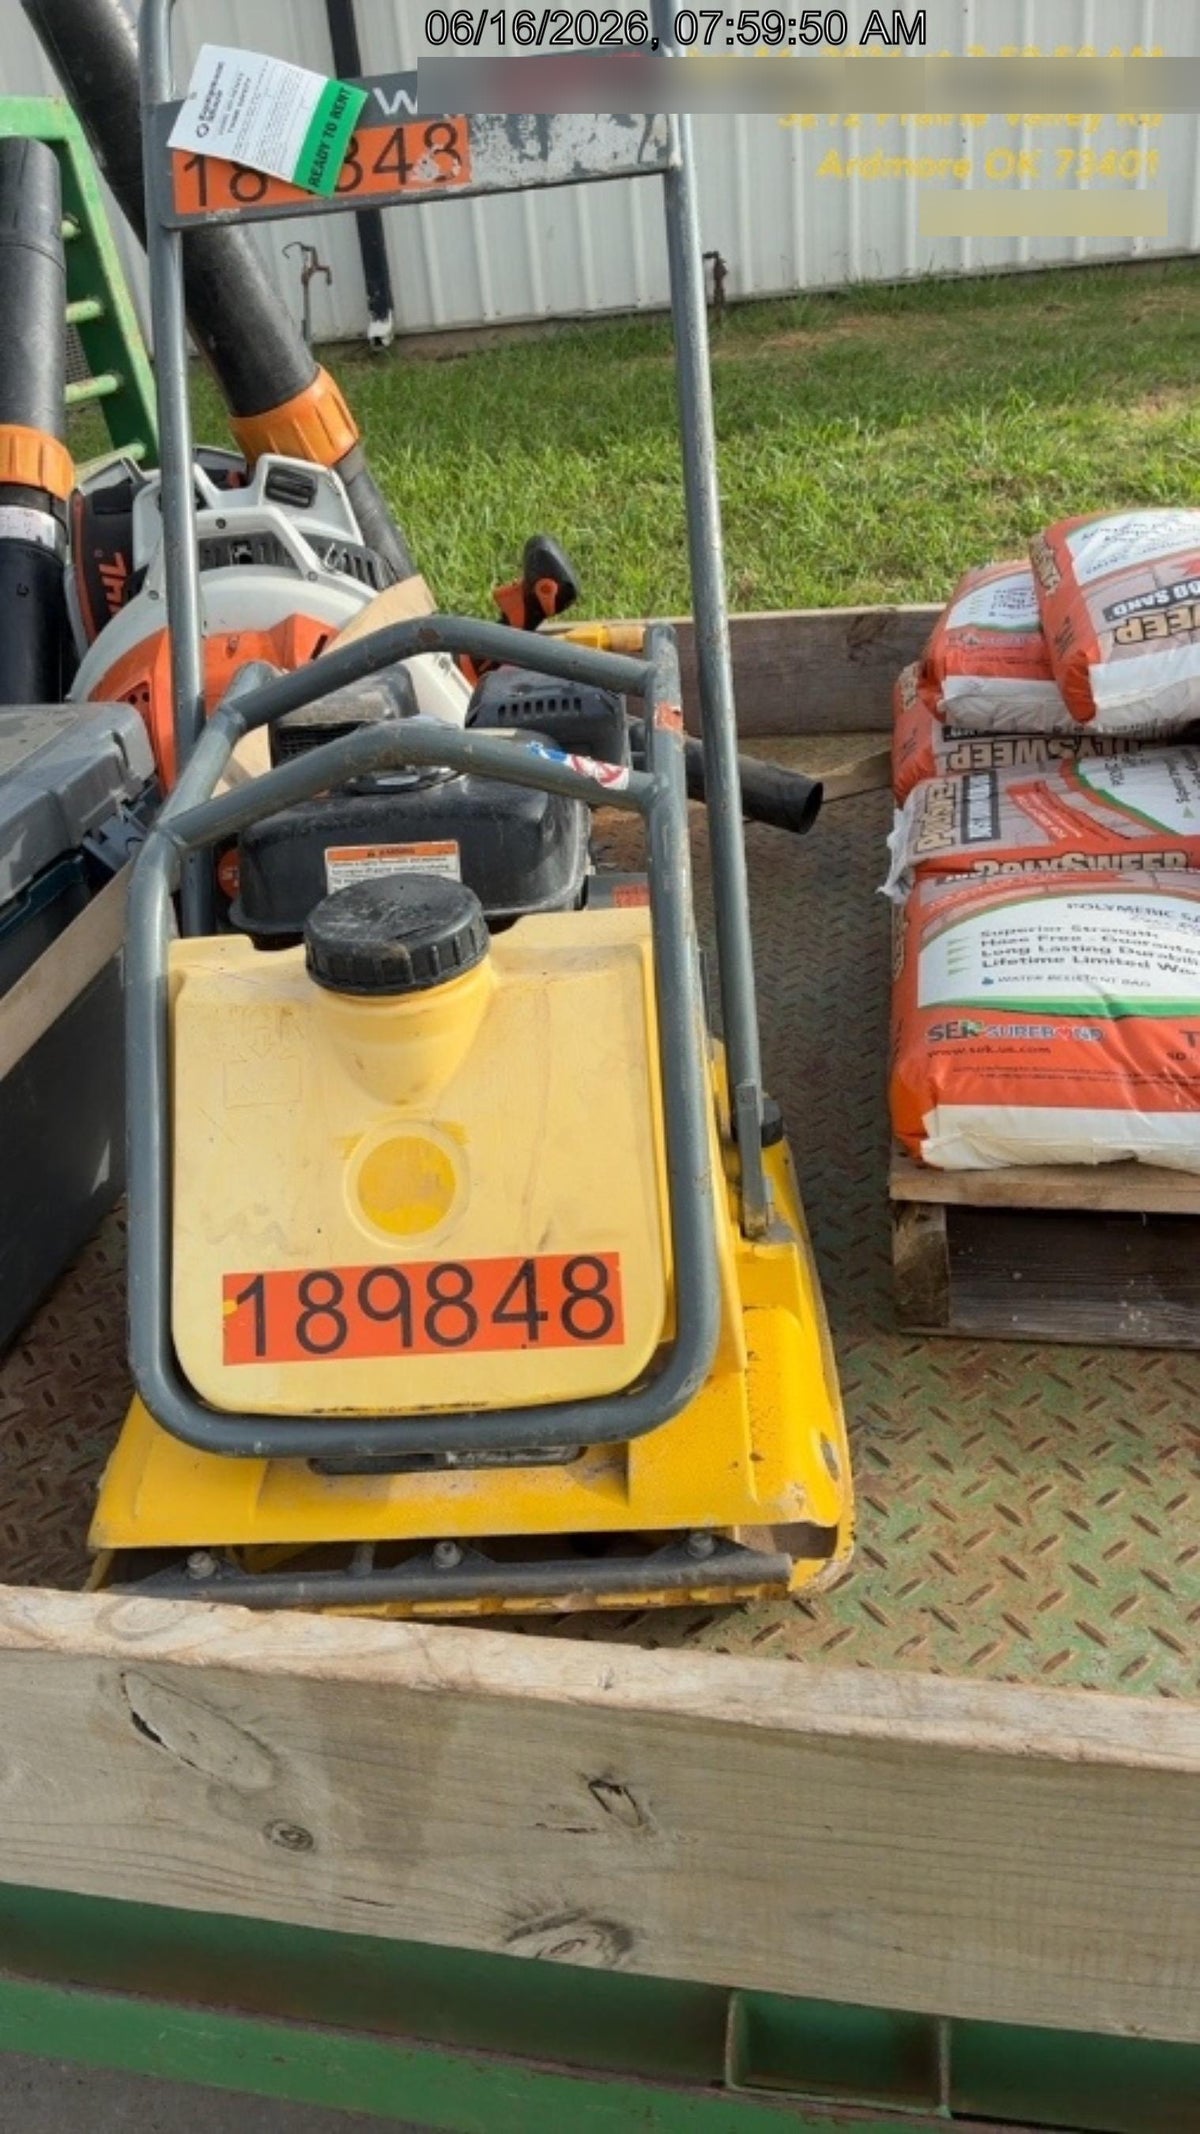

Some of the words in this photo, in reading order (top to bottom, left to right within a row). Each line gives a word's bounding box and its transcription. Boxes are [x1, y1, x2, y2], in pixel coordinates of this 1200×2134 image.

[329, 87, 353, 119] RENT
[324, 120, 338, 141] TO
[308, 141, 333, 188] READY
[981, 925, 1063, 937] Superior
[981, 947, 1030, 957] Long
[1038, 945, 1111, 955] Lasting
[981, 957, 1065, 968] Lifetime
[1073, 957, 1150, 969] Limited
[236, 1256, 614, 1357] 189848
